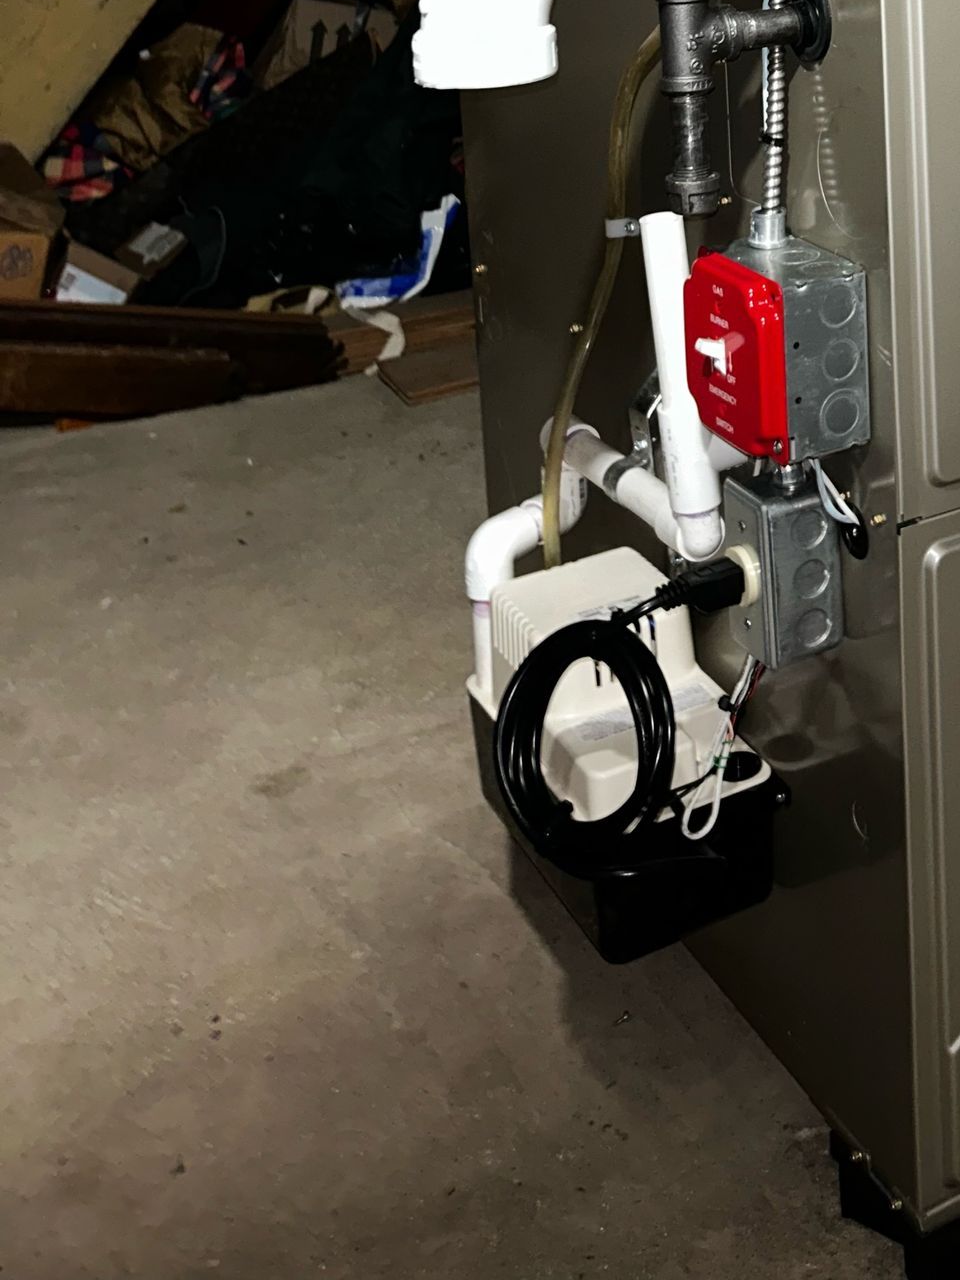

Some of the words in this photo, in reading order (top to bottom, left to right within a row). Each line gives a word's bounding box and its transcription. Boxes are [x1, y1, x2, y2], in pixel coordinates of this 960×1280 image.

[712, 284, 724, 297] GAS
[709, 313, 729, 330] BURNER
[726, 373, 737, 384] OFF
[708, 383, 737, 406] EMERGENCY
[715, 416, 734, 434] SWITCH
